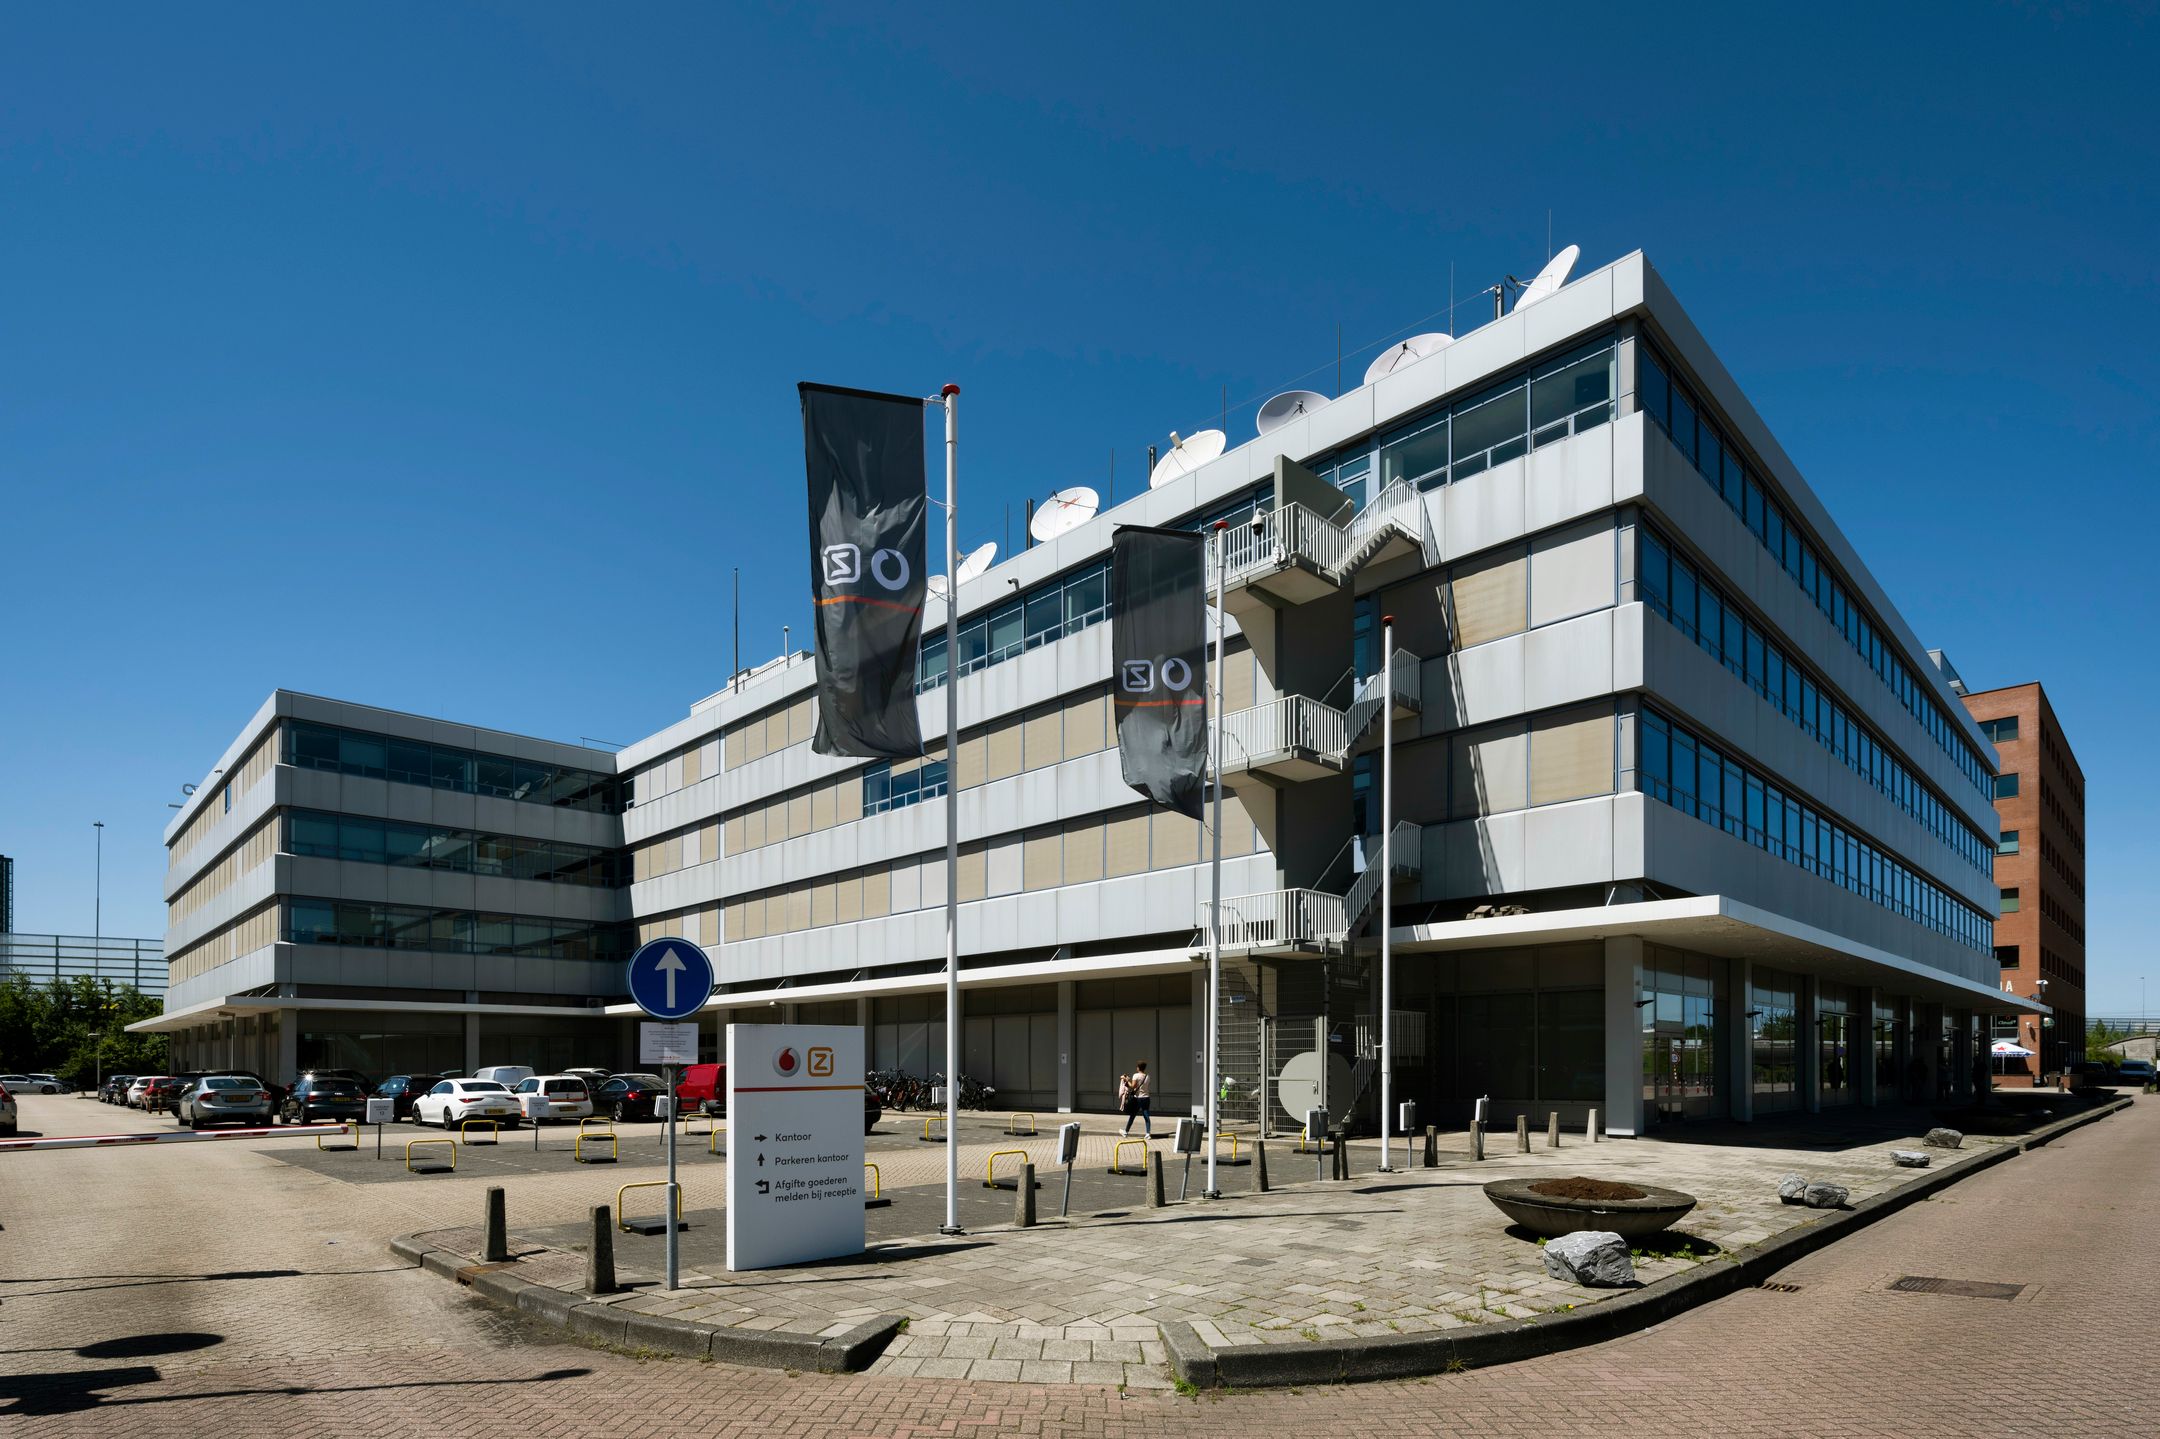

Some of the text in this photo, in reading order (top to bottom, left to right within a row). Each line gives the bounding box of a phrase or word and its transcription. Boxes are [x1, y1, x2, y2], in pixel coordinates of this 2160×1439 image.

[775, 1133, 812, 1142] Kantoor
[775, 1153, 849, 1166] Parkeren kantoor
[775, 1176, 847, 1191] Afgifte goederen
[775, 1187, 857, 1203] melden bij receptie
